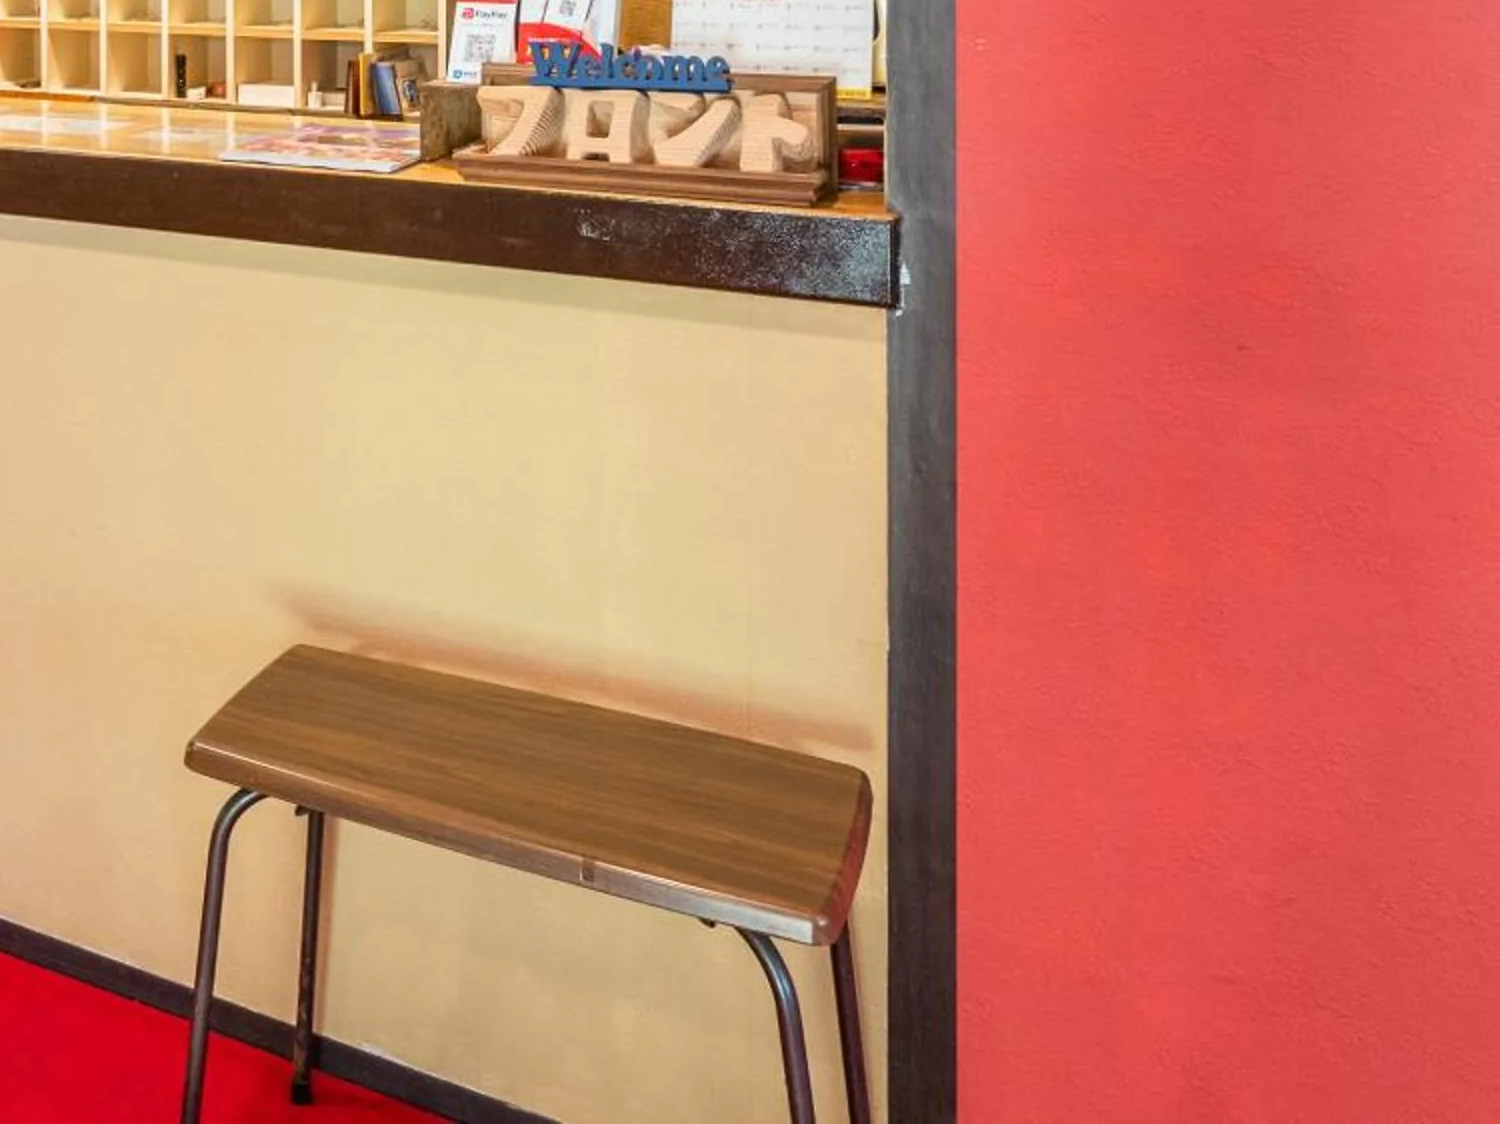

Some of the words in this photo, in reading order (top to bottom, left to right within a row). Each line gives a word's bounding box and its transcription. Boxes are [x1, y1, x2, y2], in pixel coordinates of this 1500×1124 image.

[529, 41, 732, 88] Welcome
[476, 85, 810, 174] フロント
